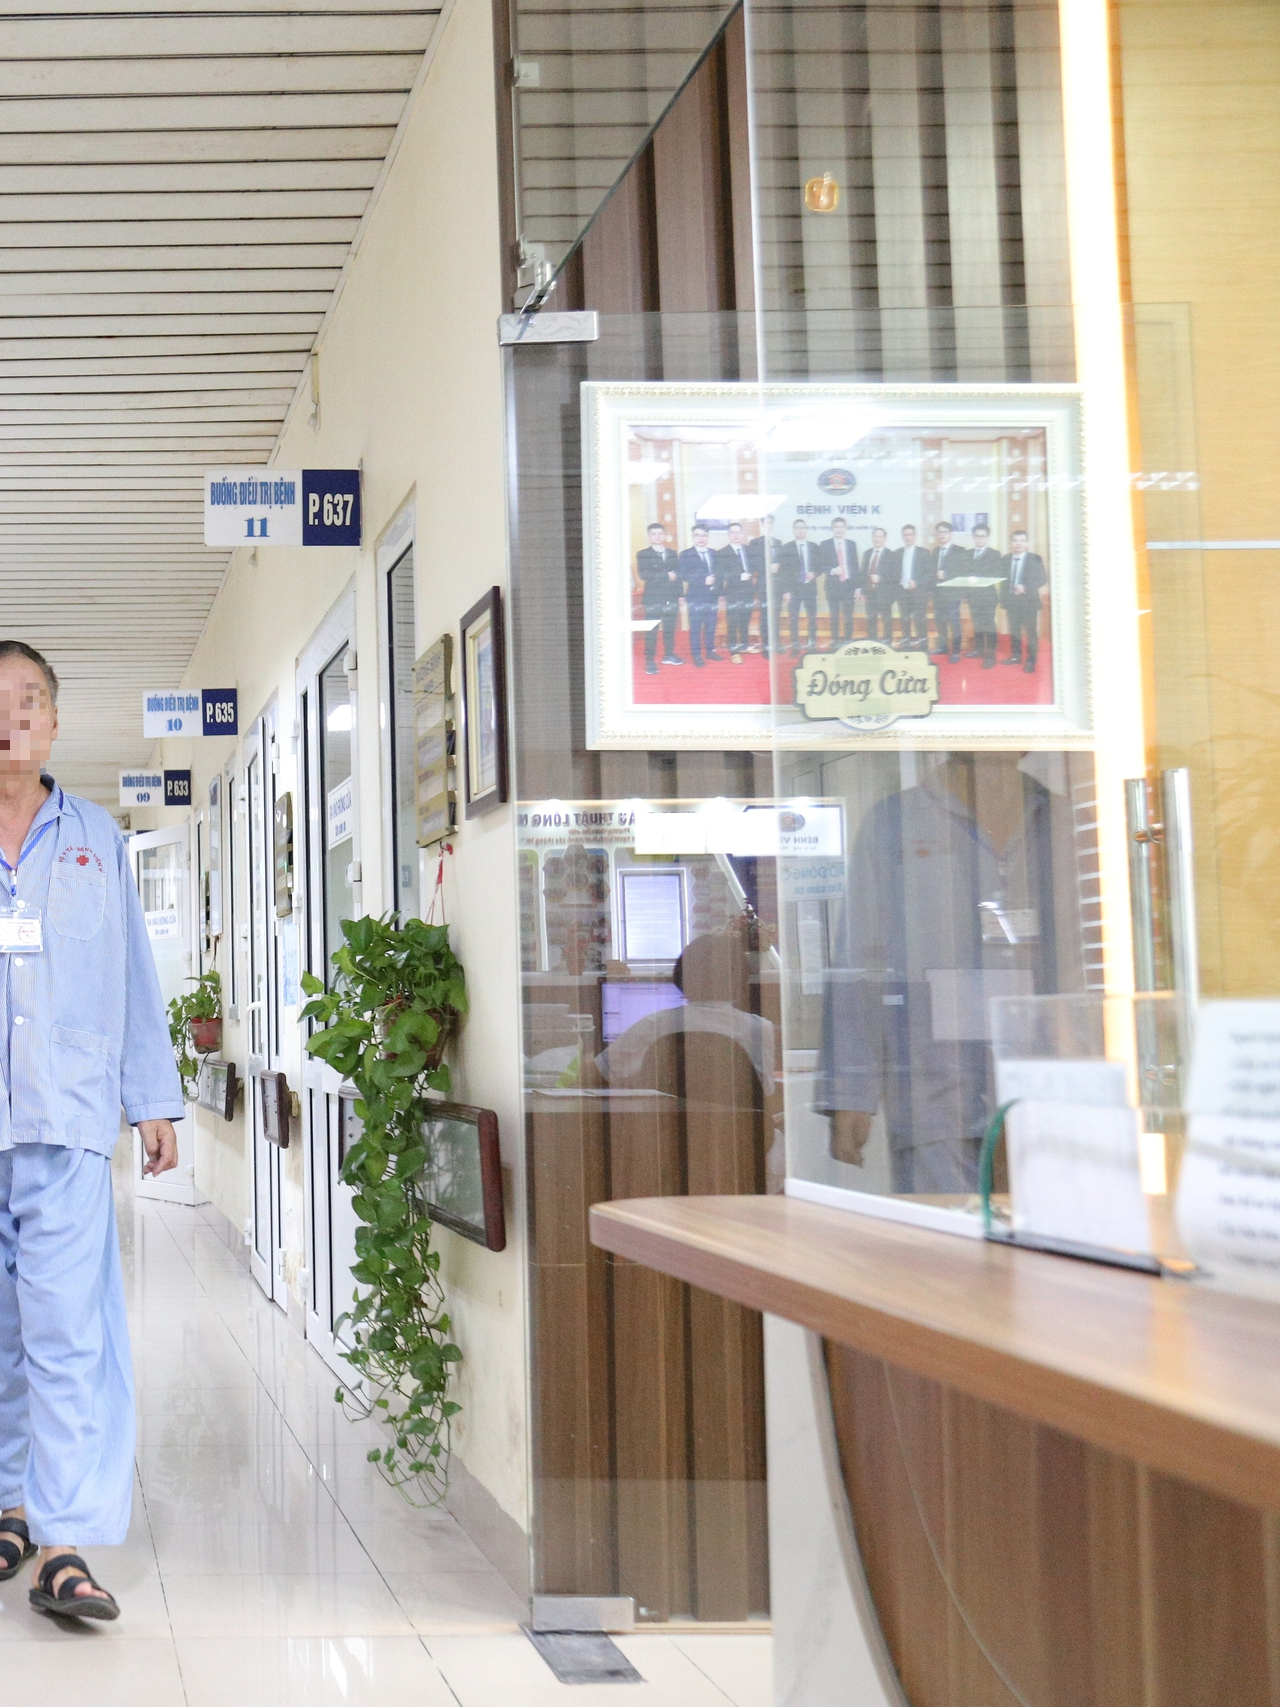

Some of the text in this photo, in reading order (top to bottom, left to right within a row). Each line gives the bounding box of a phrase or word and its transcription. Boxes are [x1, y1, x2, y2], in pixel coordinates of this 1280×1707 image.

[210, 476, 296, 509] BUỒNG ĐIỀU TRỊ BỆNH
[796, 502, 881, 517] BỆNH VIỆN K
[244, 517, 270, 538] 11
[806, 669, 930, 702] Đóng Cửa
[166, 718, 183, 732] 10
[136, 792, 151, 803] 09
